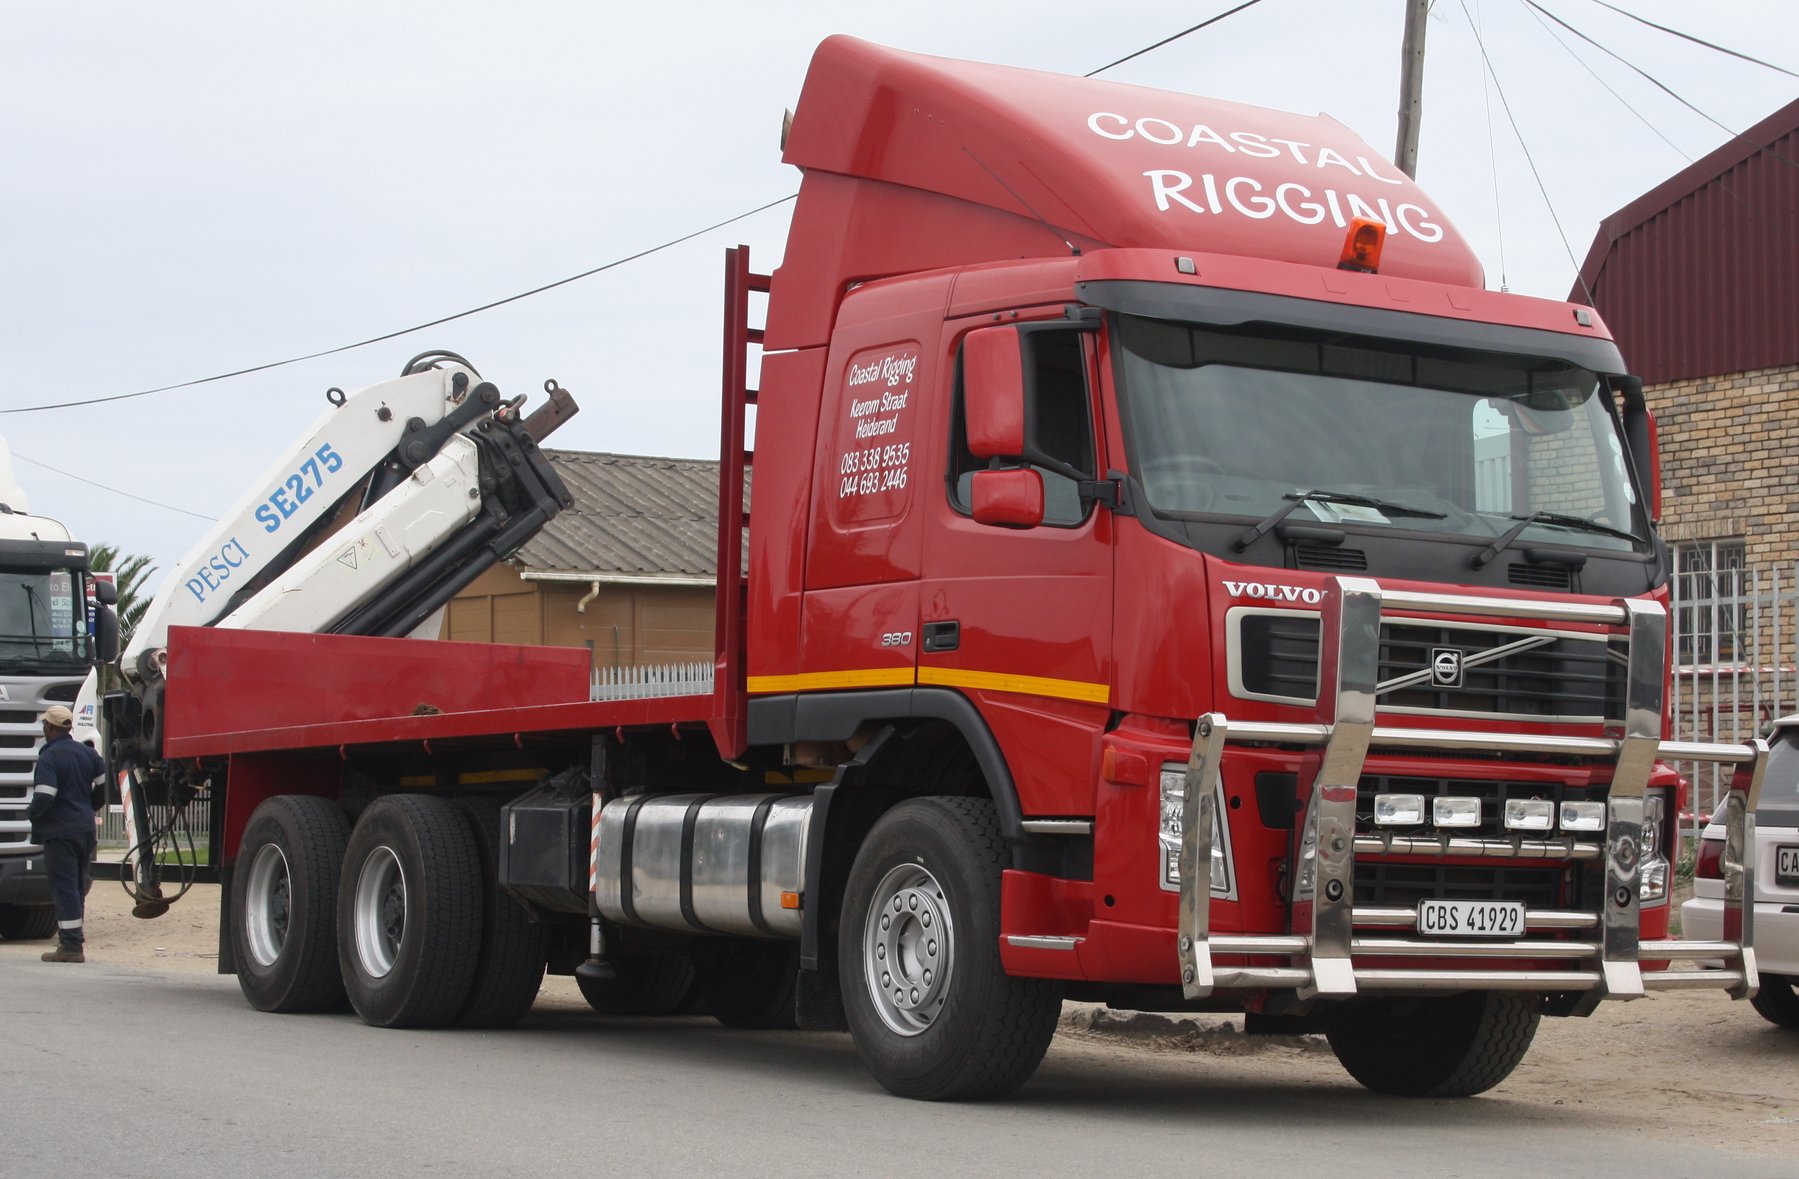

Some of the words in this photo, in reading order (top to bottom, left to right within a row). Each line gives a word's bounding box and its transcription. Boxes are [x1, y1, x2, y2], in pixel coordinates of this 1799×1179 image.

[1087, 112, 1403, 184] COASTAL
[1142, 169, 1443, 243] RIGGING
[849, 360, 881, 386] Coastal
[881, 353, 917, 387] Rigging
[850, 398, 880, 418] Keerom
[880, 390, 908, 412] Straat
[856, 413, 898, 438] Heiderand
[841, 451, 859, 475] 083
[861, 447, 881, 471] 338
[882, 442, 910, 468] 9535
[840, 474, 858, 498] 044
[859, 471, 880, 495] 693
[880, 467, 908, 492] 2446
[185, 537, 250, 604] PESCI
[254, 442, 344, 534] SE275
[1222, 580, 1321, 605] VOLVO
[882, 632, 912, 646] 380
[1781, 852, 1799, 873] CA
[1426, 905, 1459, 931] CBS
[1466, 906, 1518, 932] 41929
